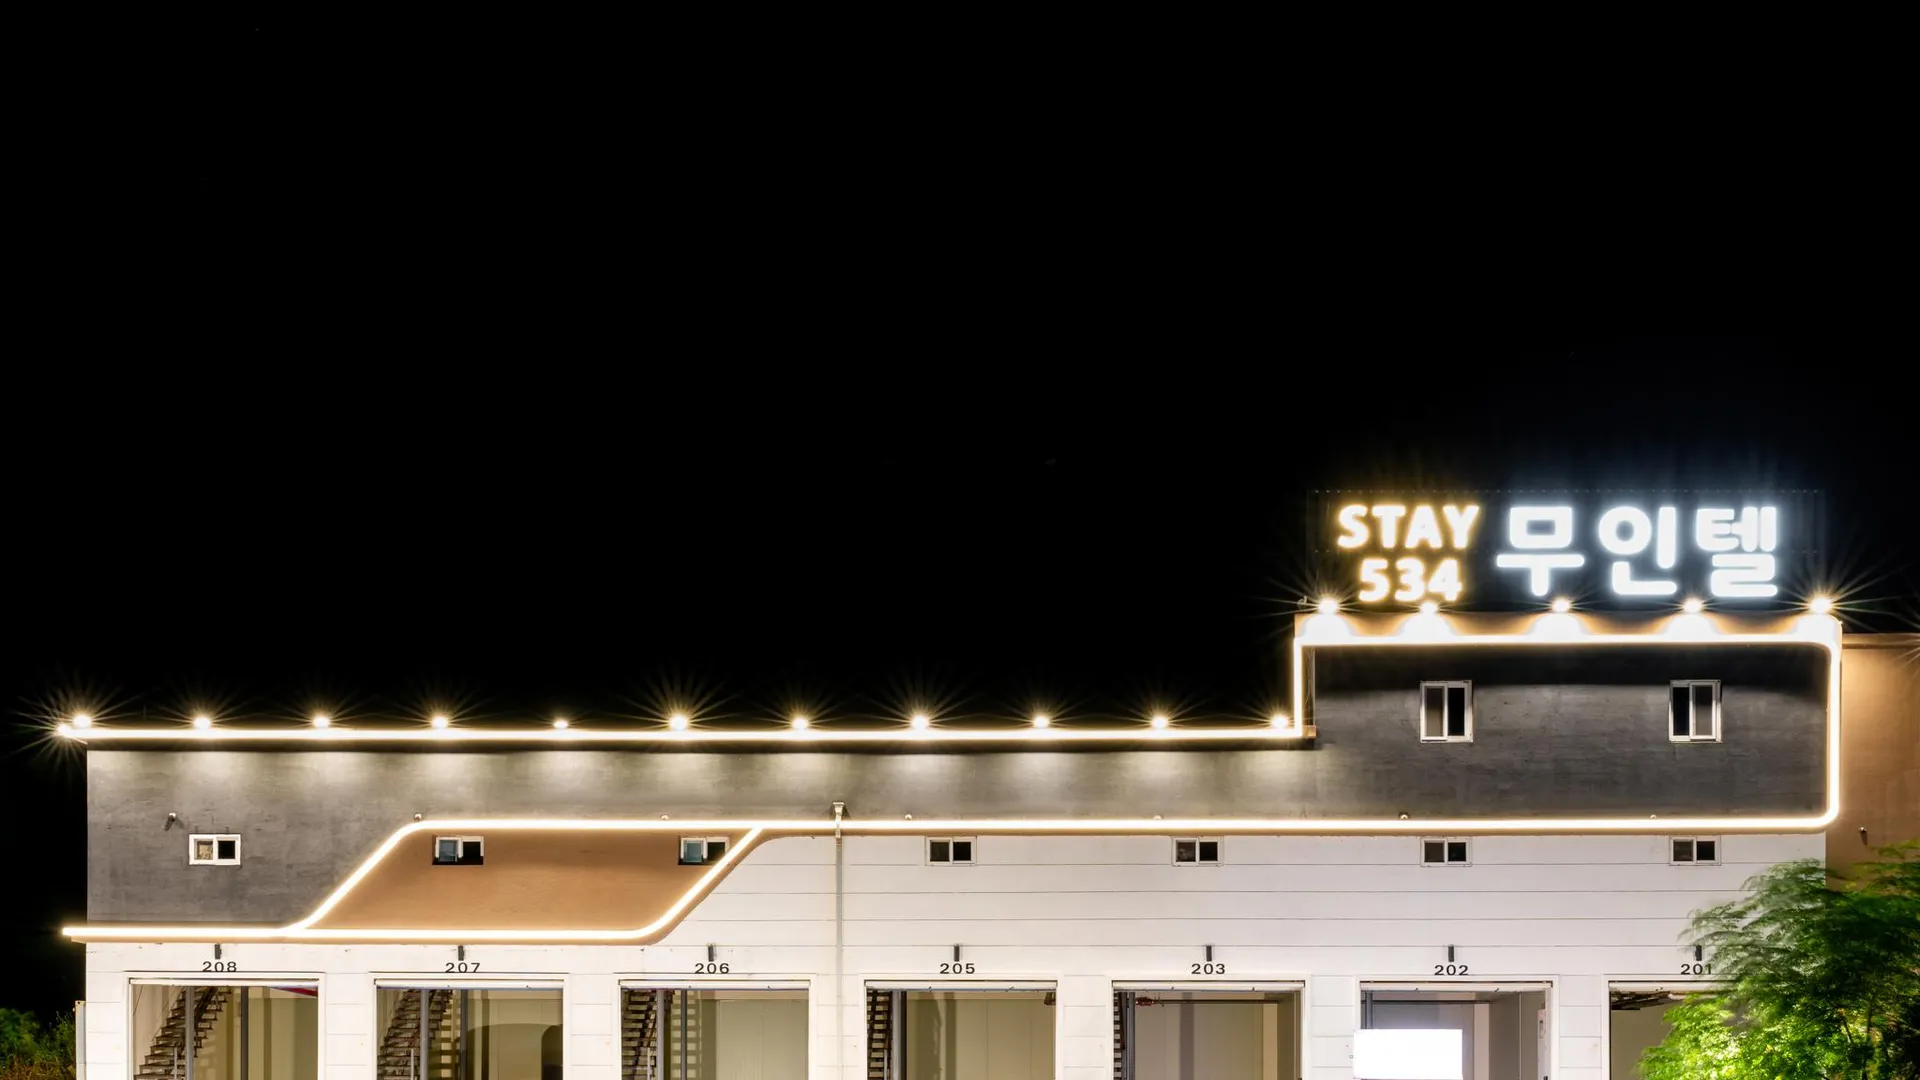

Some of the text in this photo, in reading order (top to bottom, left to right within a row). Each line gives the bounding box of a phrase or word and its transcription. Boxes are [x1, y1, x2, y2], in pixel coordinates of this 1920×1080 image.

[1337, 504, 1480, 549] STAY
[1496, 506, 1779, 597] 무인텔
[1358, 557, 1463, 601] 534
[202, 961, 237, 972] 208
[445, 962, 480, 973] 207
[694, 963, 730, 974] 206
[939, 963, 975, 974] 205
[1191, 963, 1226, 974] 203
[1434, 964, 1469, 975] 202
[1680, 963, 1713, 975] 201
